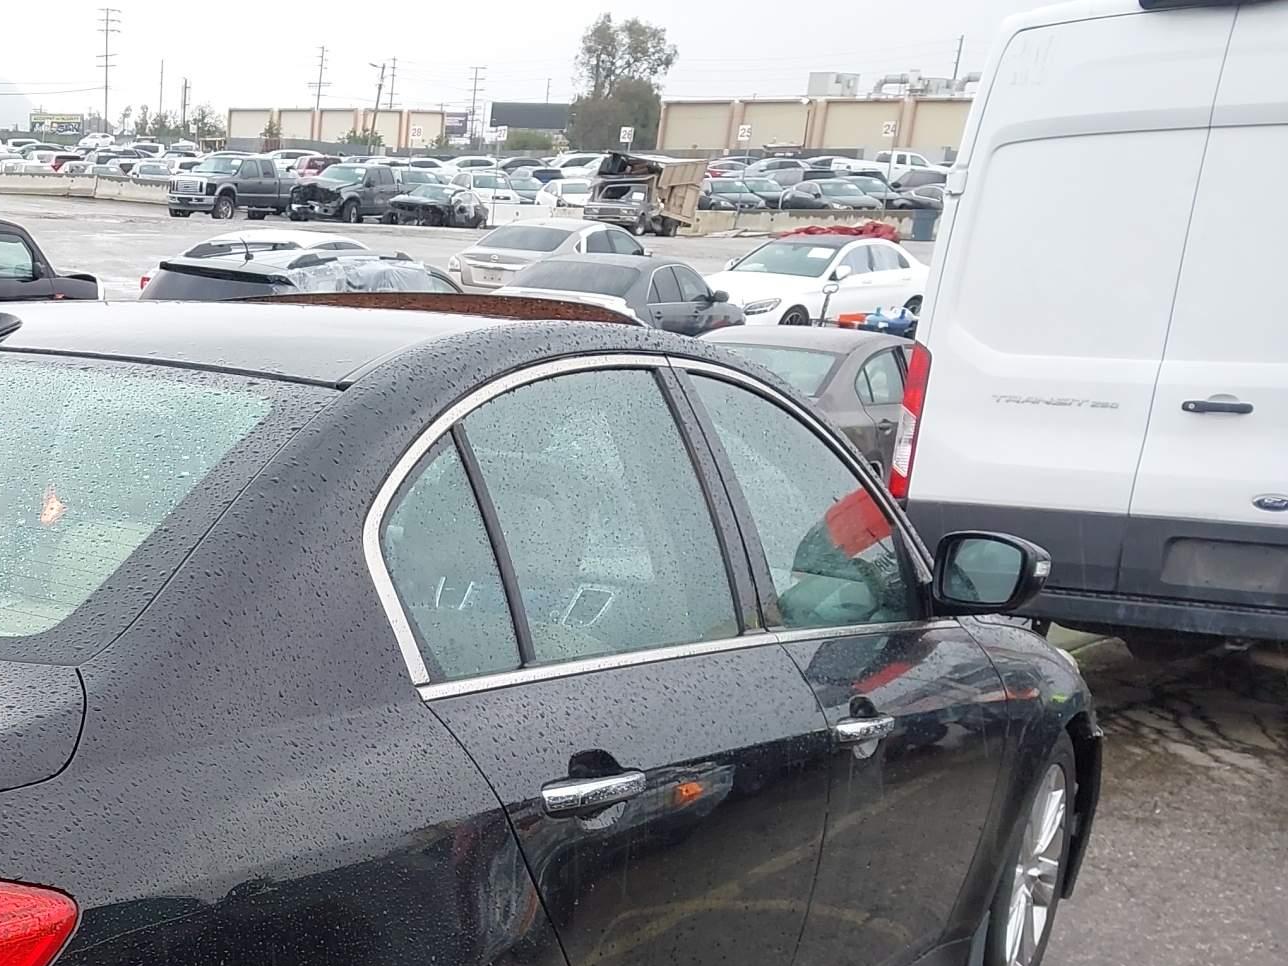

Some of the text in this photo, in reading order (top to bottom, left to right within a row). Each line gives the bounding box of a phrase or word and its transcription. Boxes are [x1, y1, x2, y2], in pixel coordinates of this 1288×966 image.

[411, 127, 423, 137] 28
[496, 128, 506, 138] 27
[621, 129, 633, 140] 26
[739, 127, 752, 138] 25
[883, 123, 897, 136] 24
